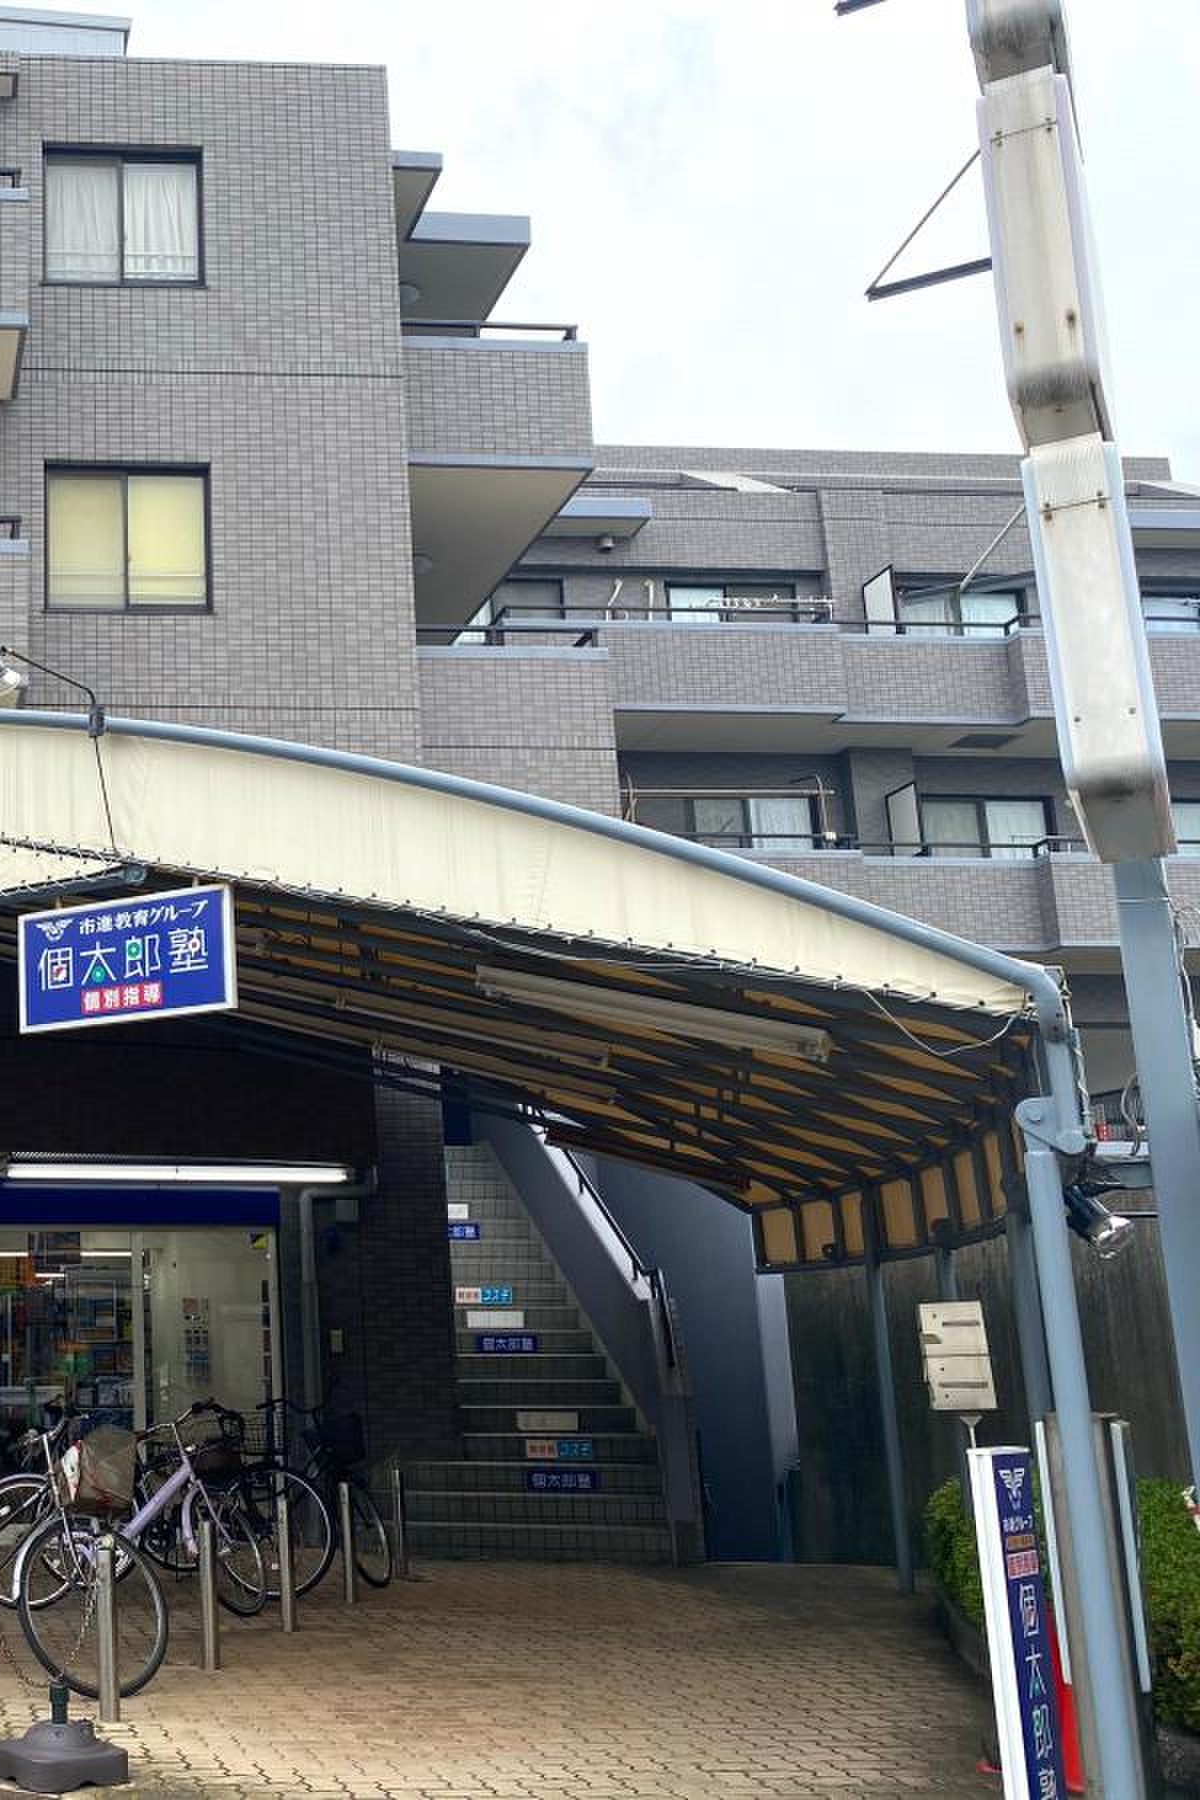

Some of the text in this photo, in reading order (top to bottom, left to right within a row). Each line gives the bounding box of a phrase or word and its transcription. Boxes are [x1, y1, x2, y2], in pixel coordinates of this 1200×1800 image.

[79, 899, 208, 935] 市進教育グループ
[37, 926, 209, 992] 個太郎塾
